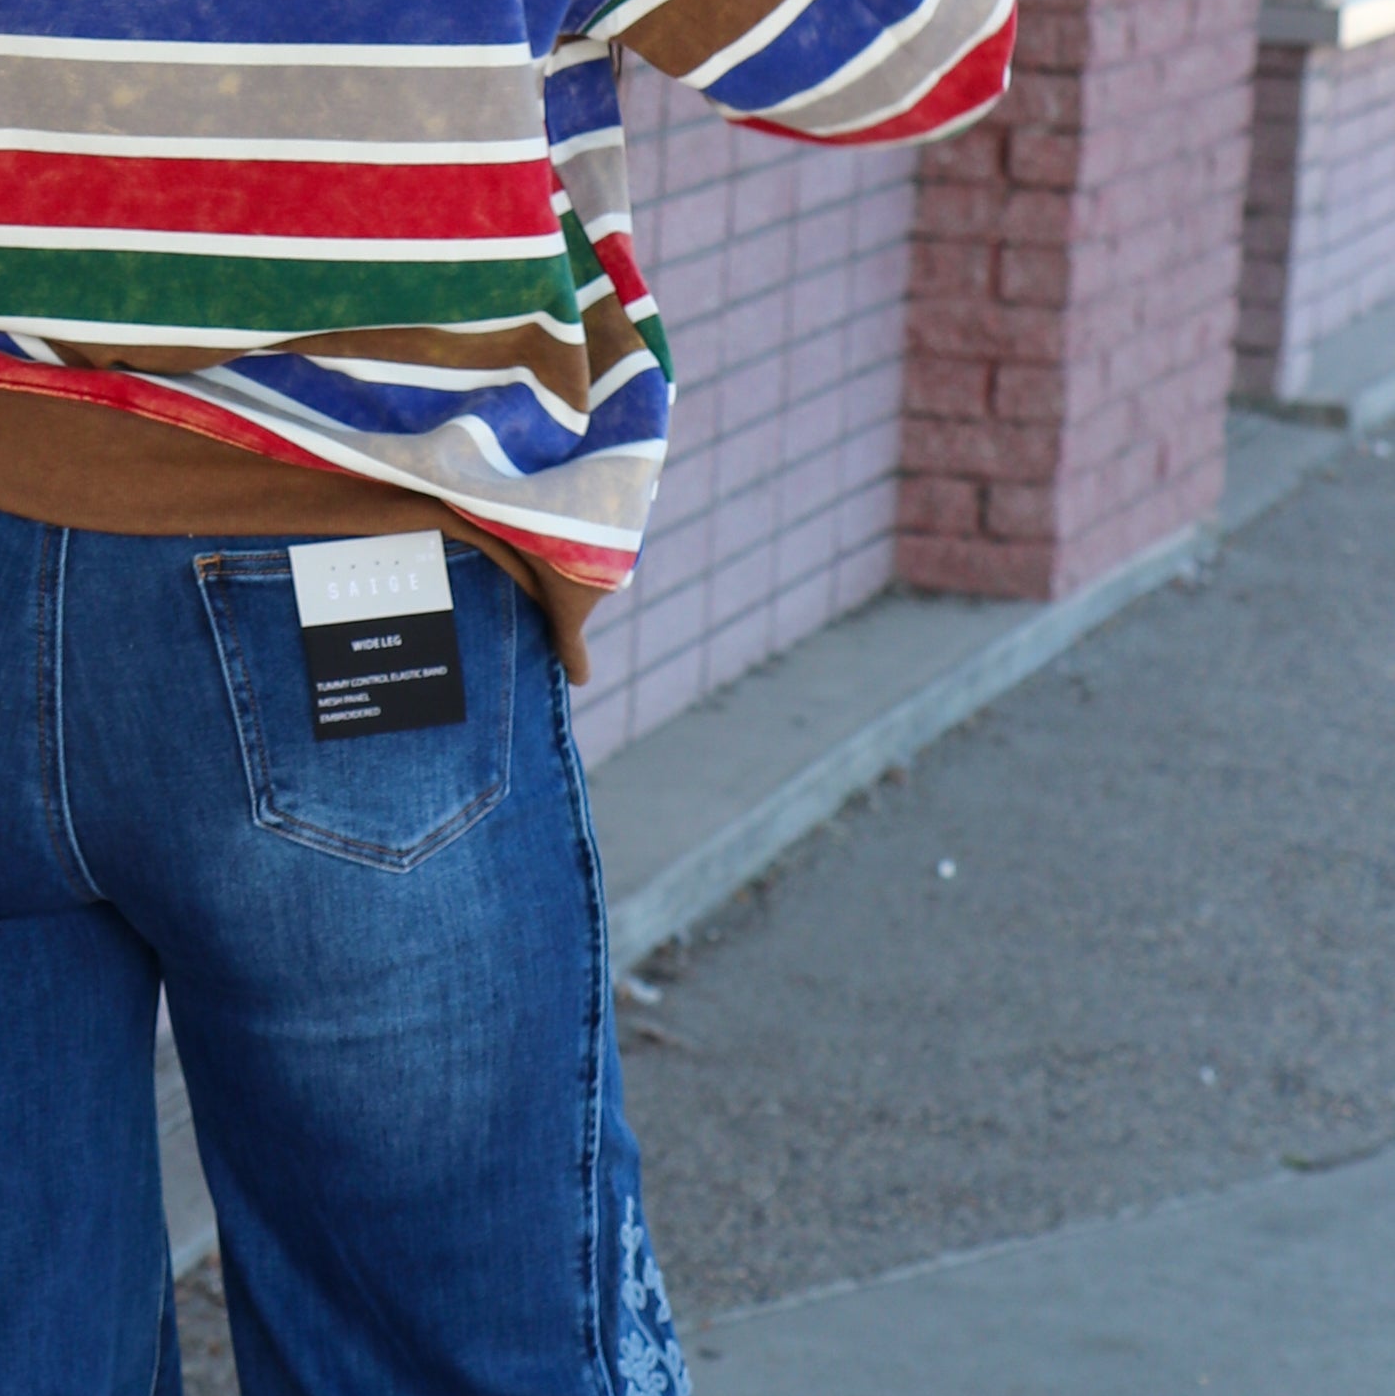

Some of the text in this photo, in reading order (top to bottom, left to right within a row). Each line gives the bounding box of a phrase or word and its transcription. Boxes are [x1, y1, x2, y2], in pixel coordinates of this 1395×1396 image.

[351, 634, 403, 652] WIDE LEG
[316, 665, 448, 692] TUMMY CONTROL ELASTIC BAND
[317, 695, 343, 707] MESH
